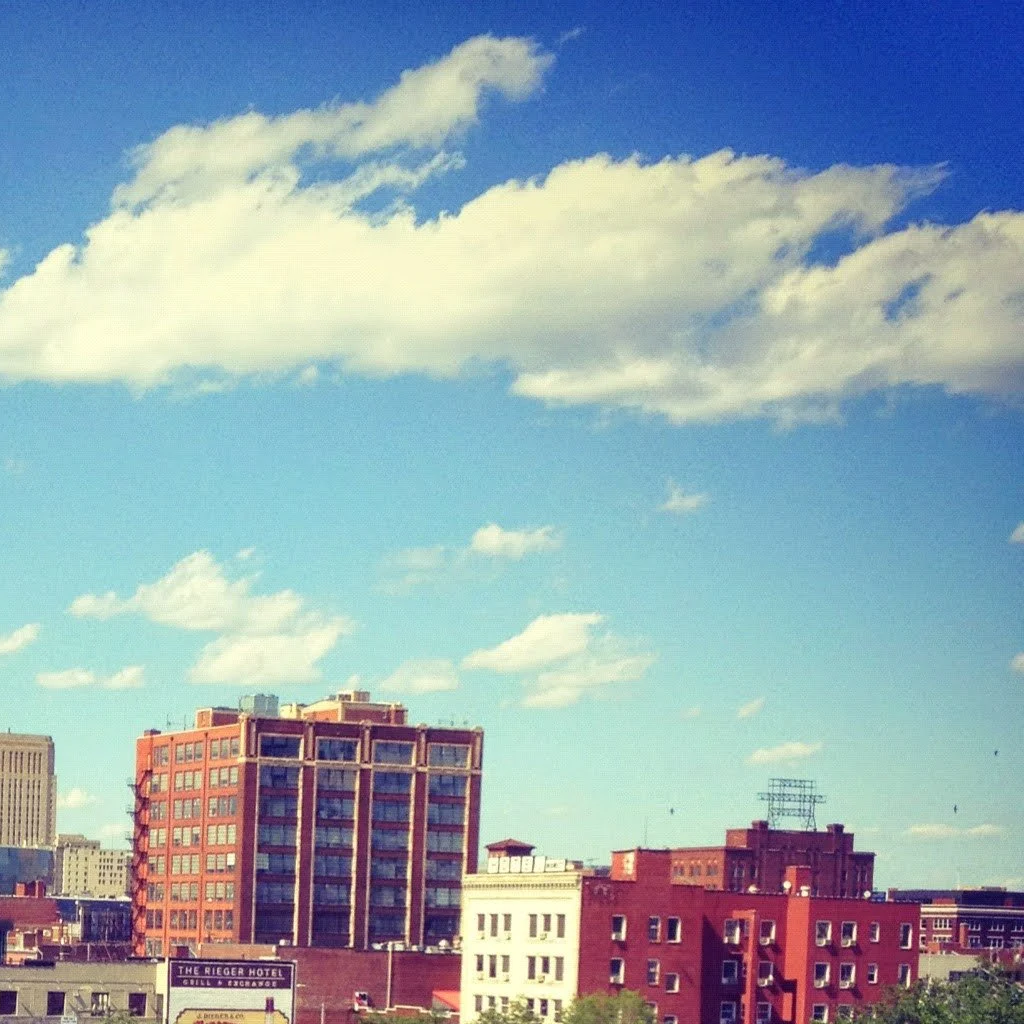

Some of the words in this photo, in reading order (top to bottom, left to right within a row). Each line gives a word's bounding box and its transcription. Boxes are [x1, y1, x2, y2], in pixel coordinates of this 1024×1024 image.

[178, 966, 200, 975] THE
[204, 967, 244, 976] RIEGER
[248, 968, 283, 977] HOTEL
